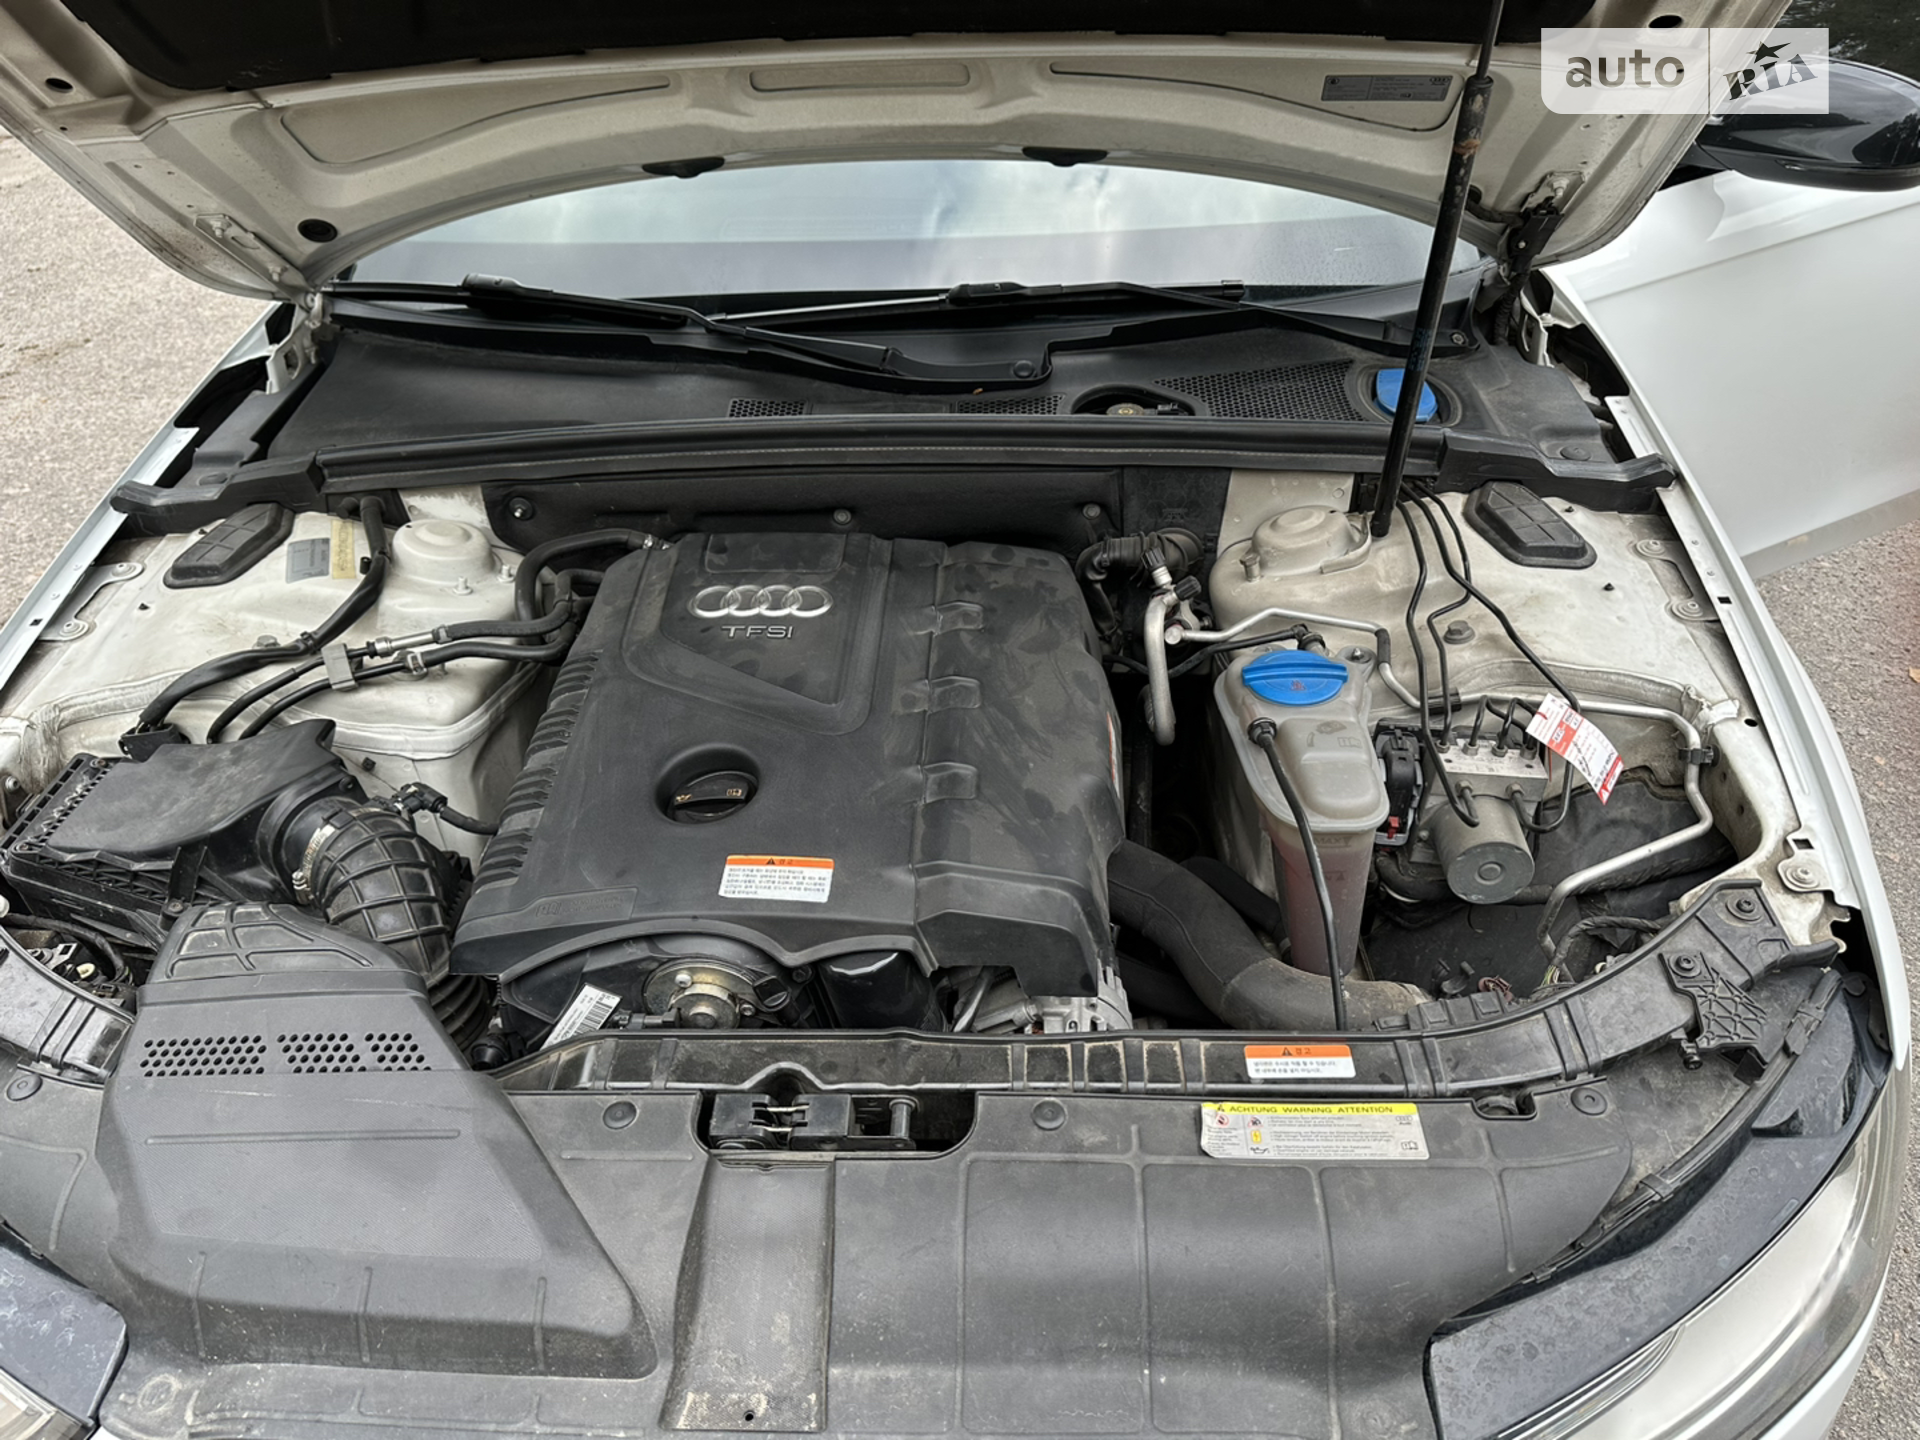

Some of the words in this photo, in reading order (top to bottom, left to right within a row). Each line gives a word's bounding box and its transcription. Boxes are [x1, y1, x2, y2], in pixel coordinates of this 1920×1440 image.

[721, 625, 795, 640] TFSI
[1229, 1105, 1278, 1114] ACHTUNG
[1282, 1105, 1333, 1114] WARNING
[1337, 1105, 1394, 1114] ATTENTION
